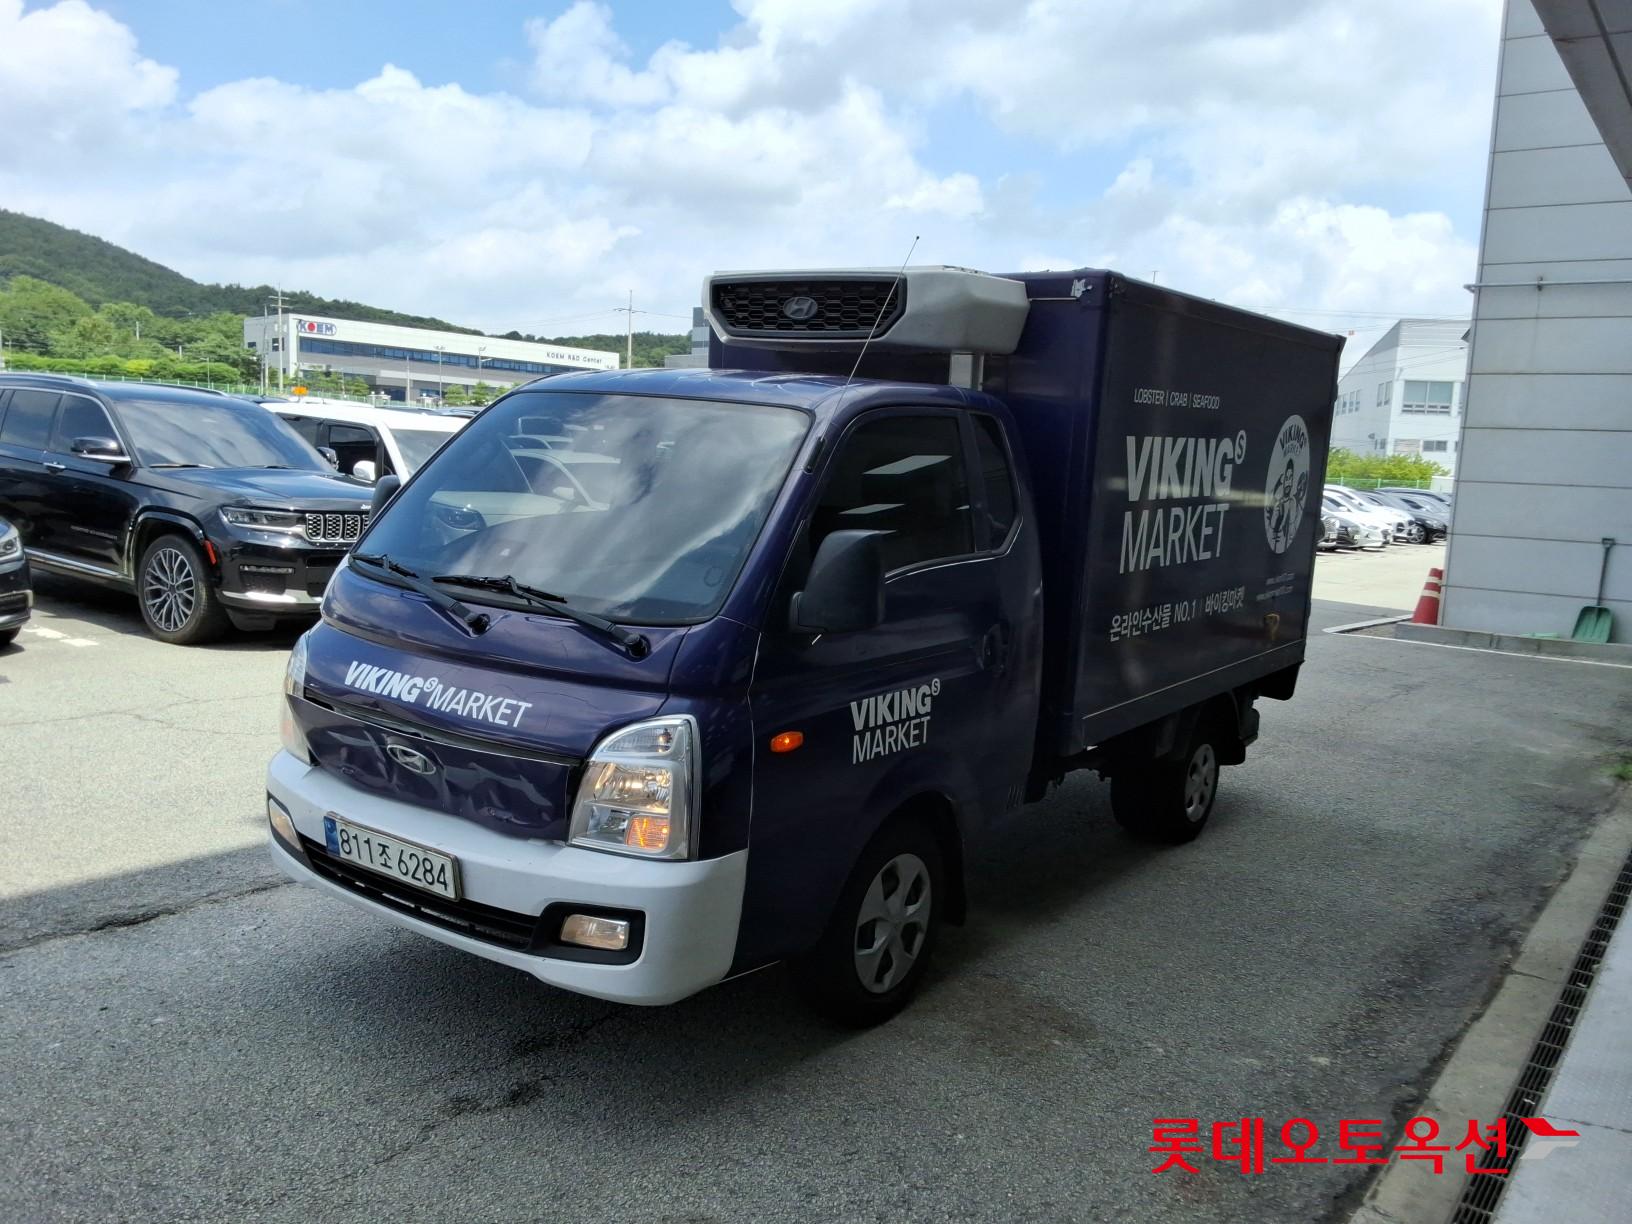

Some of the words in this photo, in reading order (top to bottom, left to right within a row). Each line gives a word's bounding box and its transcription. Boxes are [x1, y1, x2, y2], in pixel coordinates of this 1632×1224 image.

[298, 320, 336, 336] KOEM
[546, 351, 565, 360] KOEM
[1133, 387, 1165, 406] LOBSTER
[1169, 391, 1188, 407] CRAB
[1192, 393, 1220, 410] SEAFOOD
[1119, 503, 1230, 575] MARKET
[1110, 603, 1172, 642] 온라인수산물
[1204, 585, 1246, 616] 바이킹마켓
[852, 716, 931, 765] MARKET
